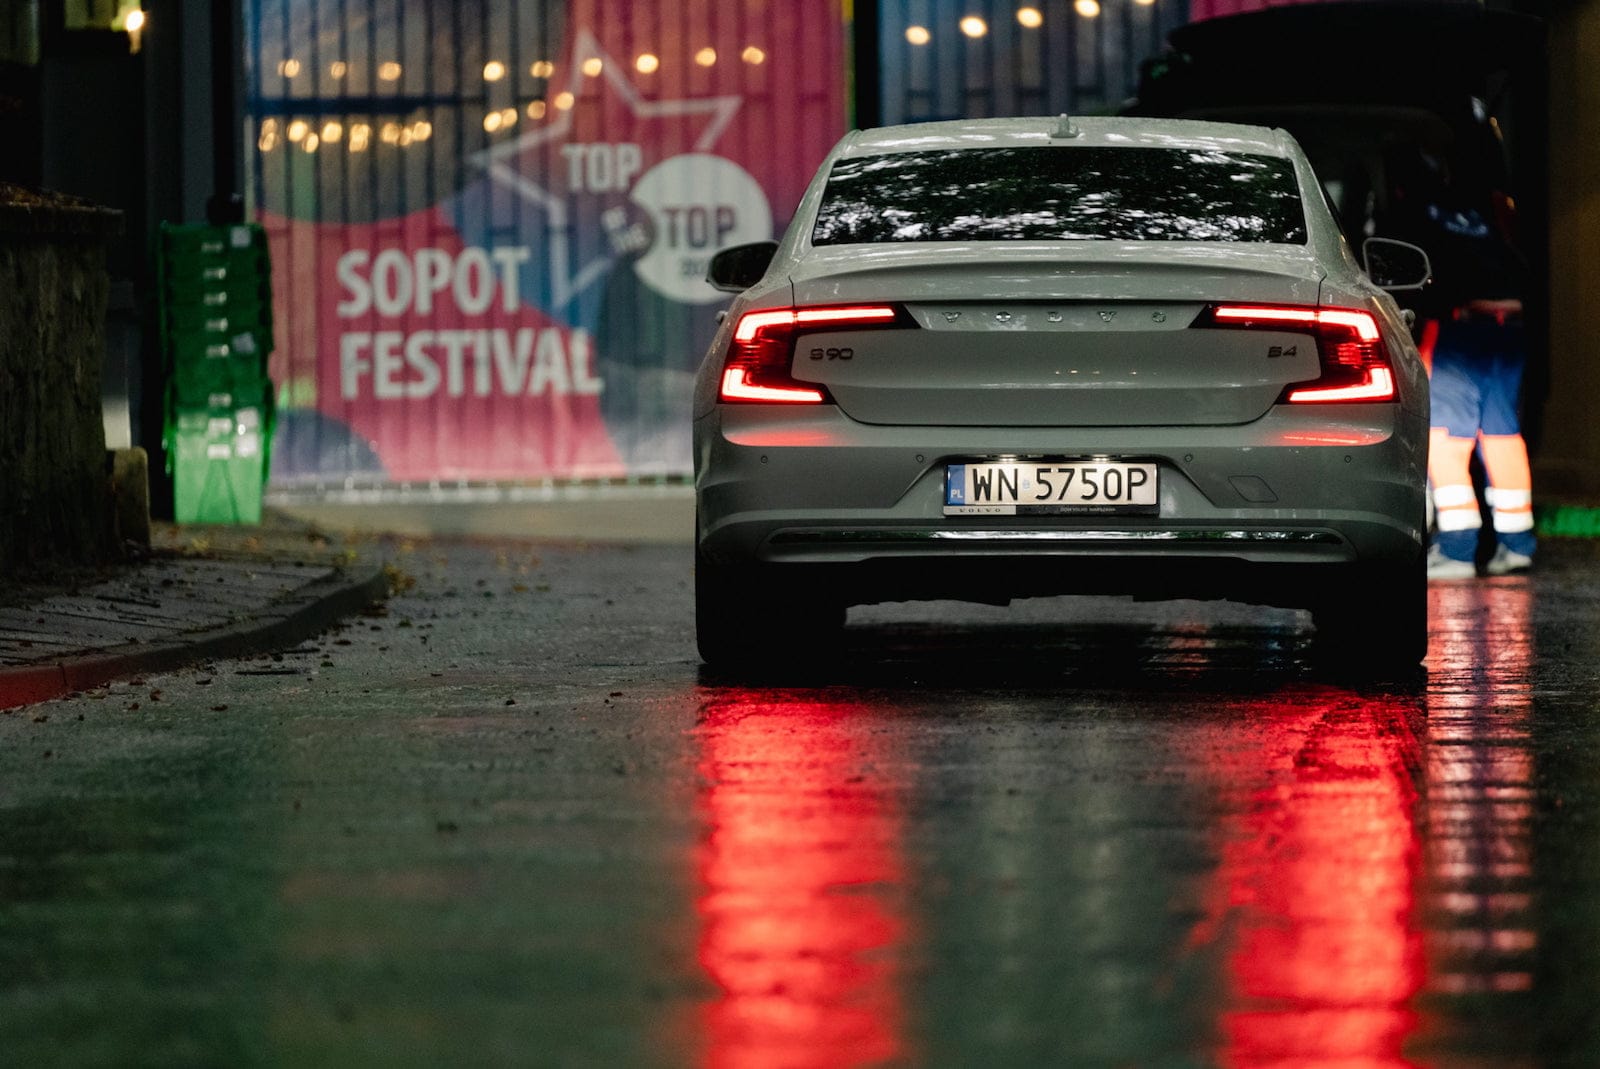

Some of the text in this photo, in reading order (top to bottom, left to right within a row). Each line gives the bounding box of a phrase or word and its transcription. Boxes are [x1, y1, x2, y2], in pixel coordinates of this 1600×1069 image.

[561, 143, 642, 193] TOP
[662, 205, 735, 248] TOP
[336, 246, 531, 318] SOPOT
[942, 311, 1167, 323] VOLVO
[340, 326, 605, 399] FESTIVAL
[809, 347, 854, 361] S90
[950, 489, 963, 498] PL
[972, 468, 1147, 501] WN 5750P
